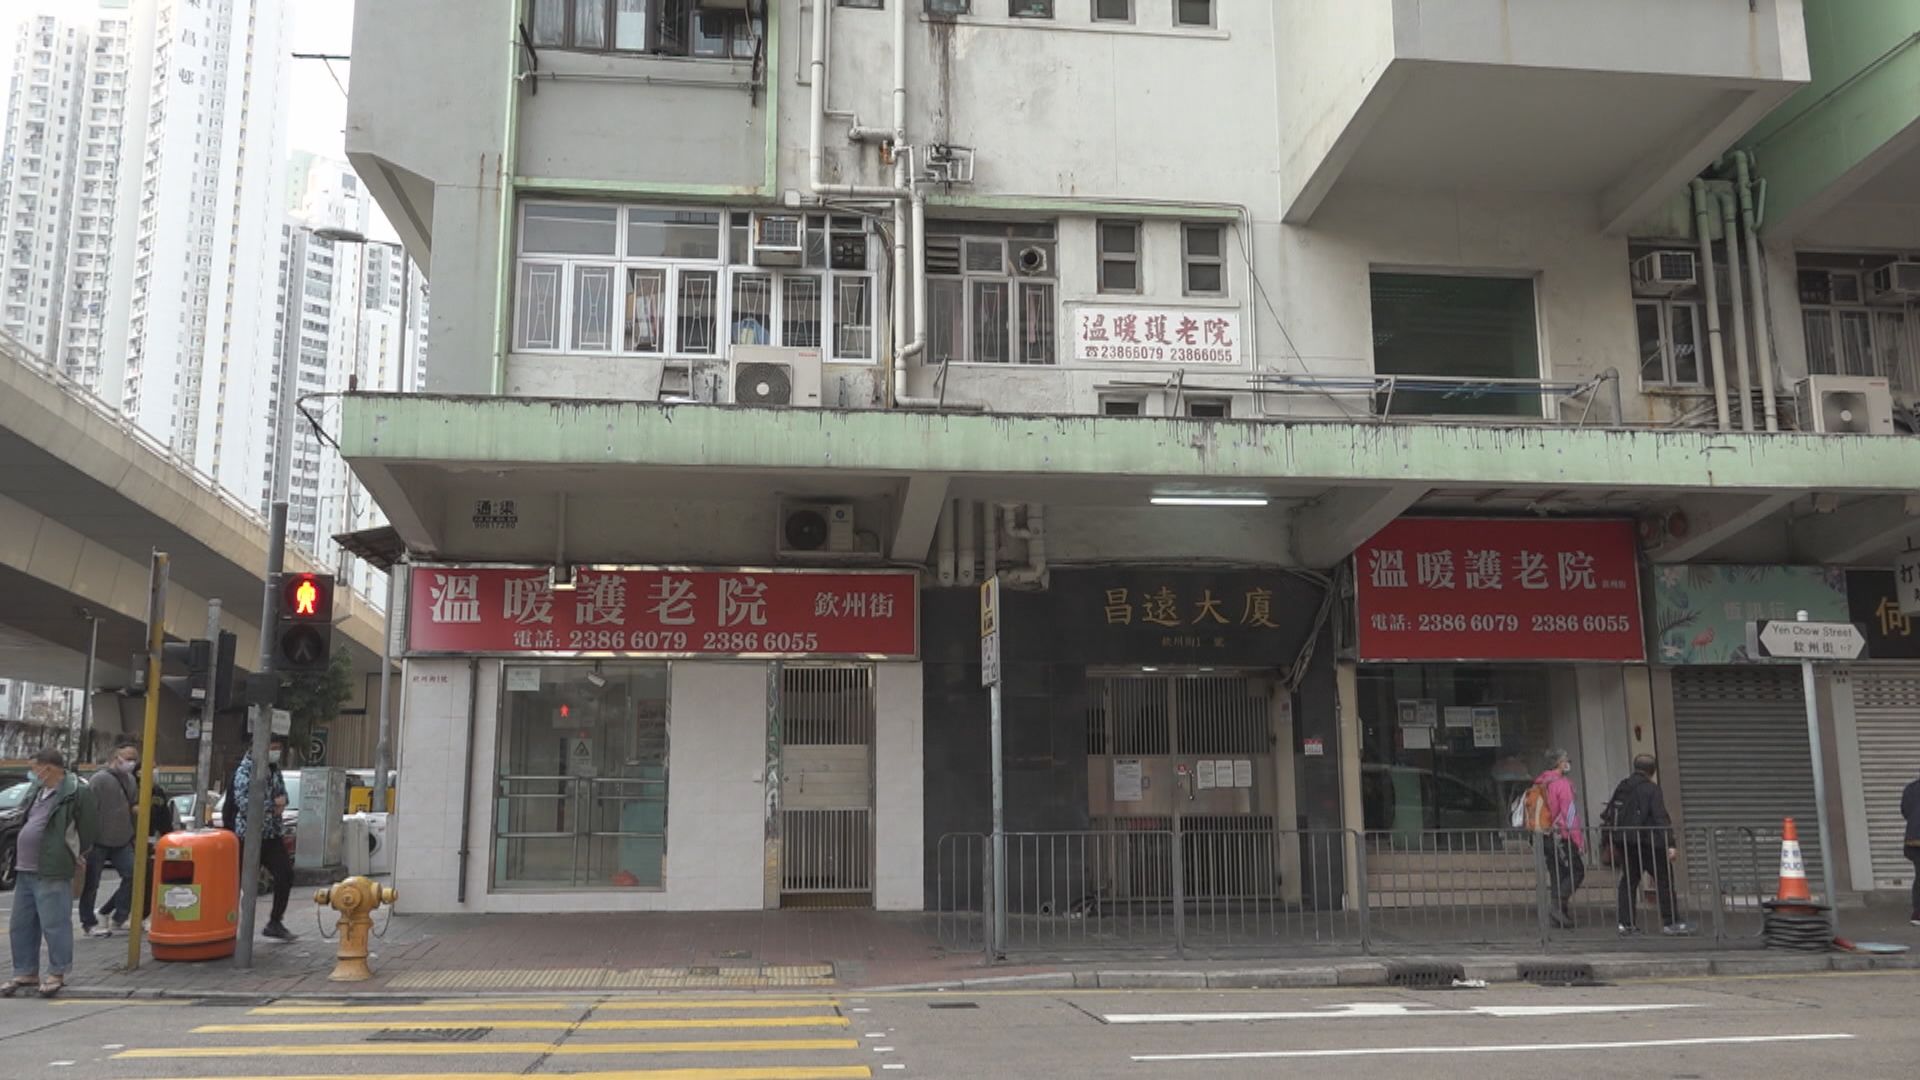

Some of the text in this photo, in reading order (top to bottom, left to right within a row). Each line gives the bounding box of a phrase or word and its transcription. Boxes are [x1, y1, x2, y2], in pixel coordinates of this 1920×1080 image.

[1101, 345, 1233, 363] 23866079 23866055
[1368, 548, 1598, 591] 溫暖護老院
[430, 573, 893, 626] 溫暖護老院 欽州街
[1103, 585, 1280, 628] 昌遠大廈
[1371, 613, 1631, 633] 電話: 2386 6079 2386 6055
[1876, 597, 1911, 636] 何
[514, 630, 818, 651] 電話: 2386 6079 2386 6055
[1772, 624, 1852, 637] Yen Chow Street
[1793, 640, 1834, 653] 欽州街
